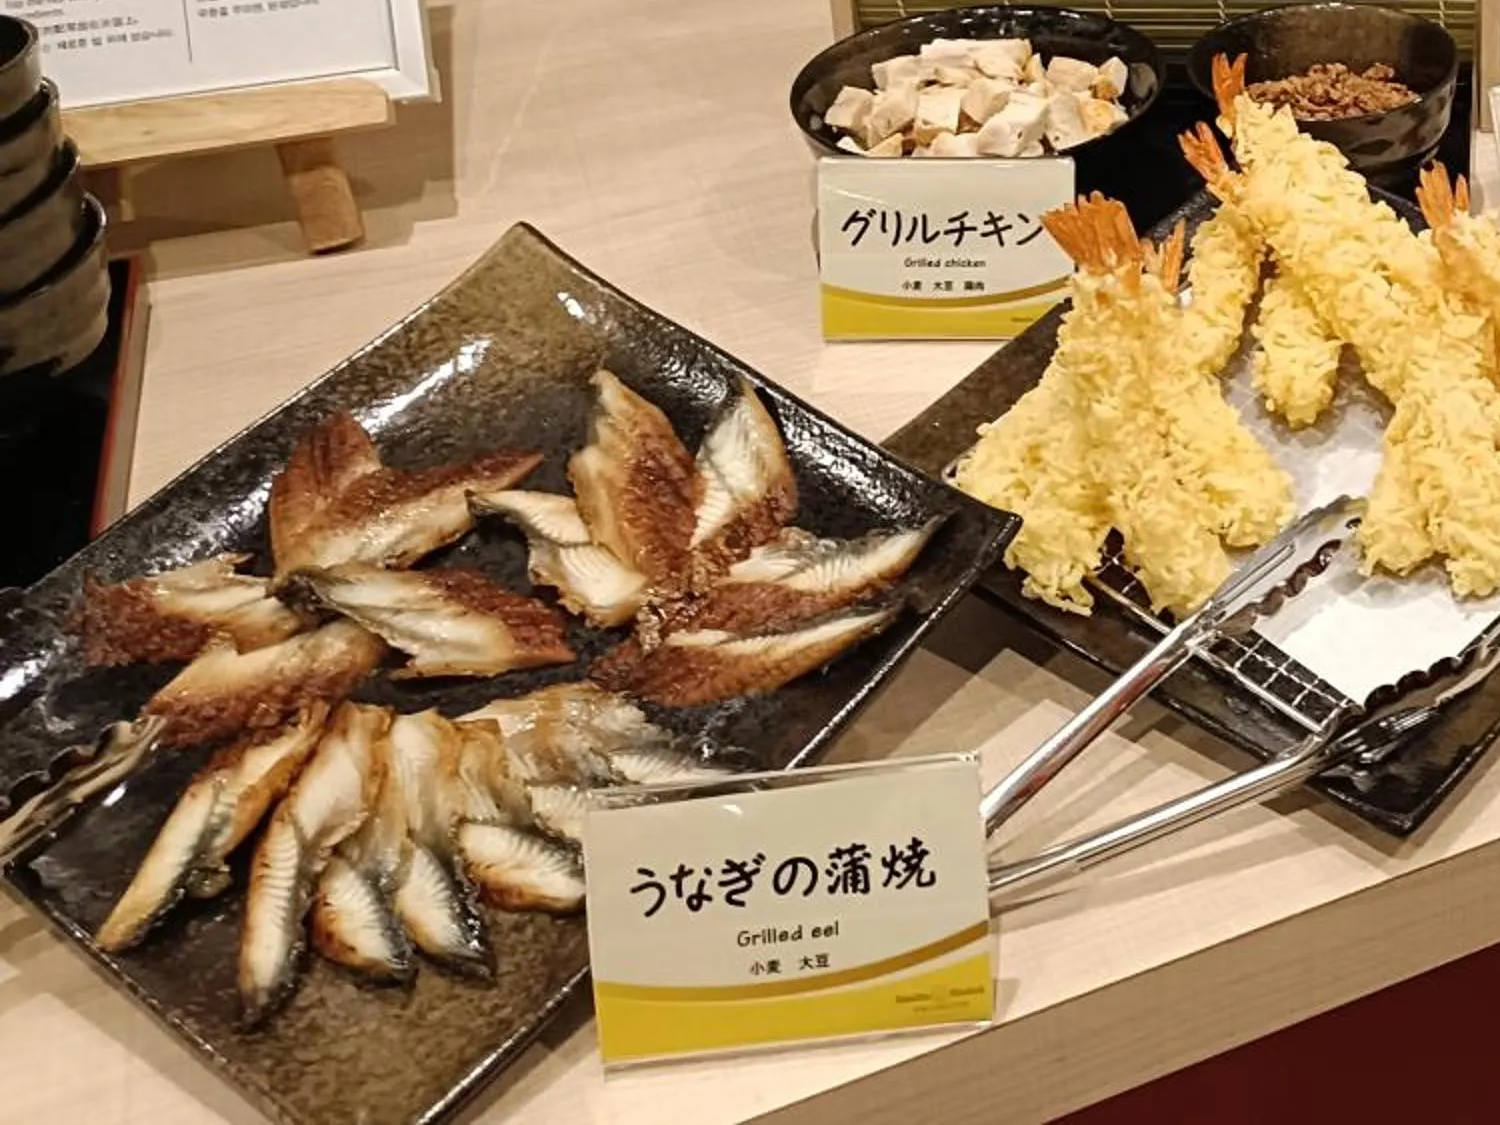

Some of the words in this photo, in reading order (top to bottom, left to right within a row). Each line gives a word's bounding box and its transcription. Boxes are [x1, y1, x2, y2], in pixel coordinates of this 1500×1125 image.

[841, 208, 1044, 247] グリルチキン
[904, 257, 941, 268] Grilled
[945, 257, 986, 268] chicken
[629, 836, 937, 918] うなぎの蒲焼
[736, 925, 803, 947] Grilled
[811, 921, 840, 939] eel
[749, 959, 781, 976] 小麦
[799, 953, 831, 971] 大豆
